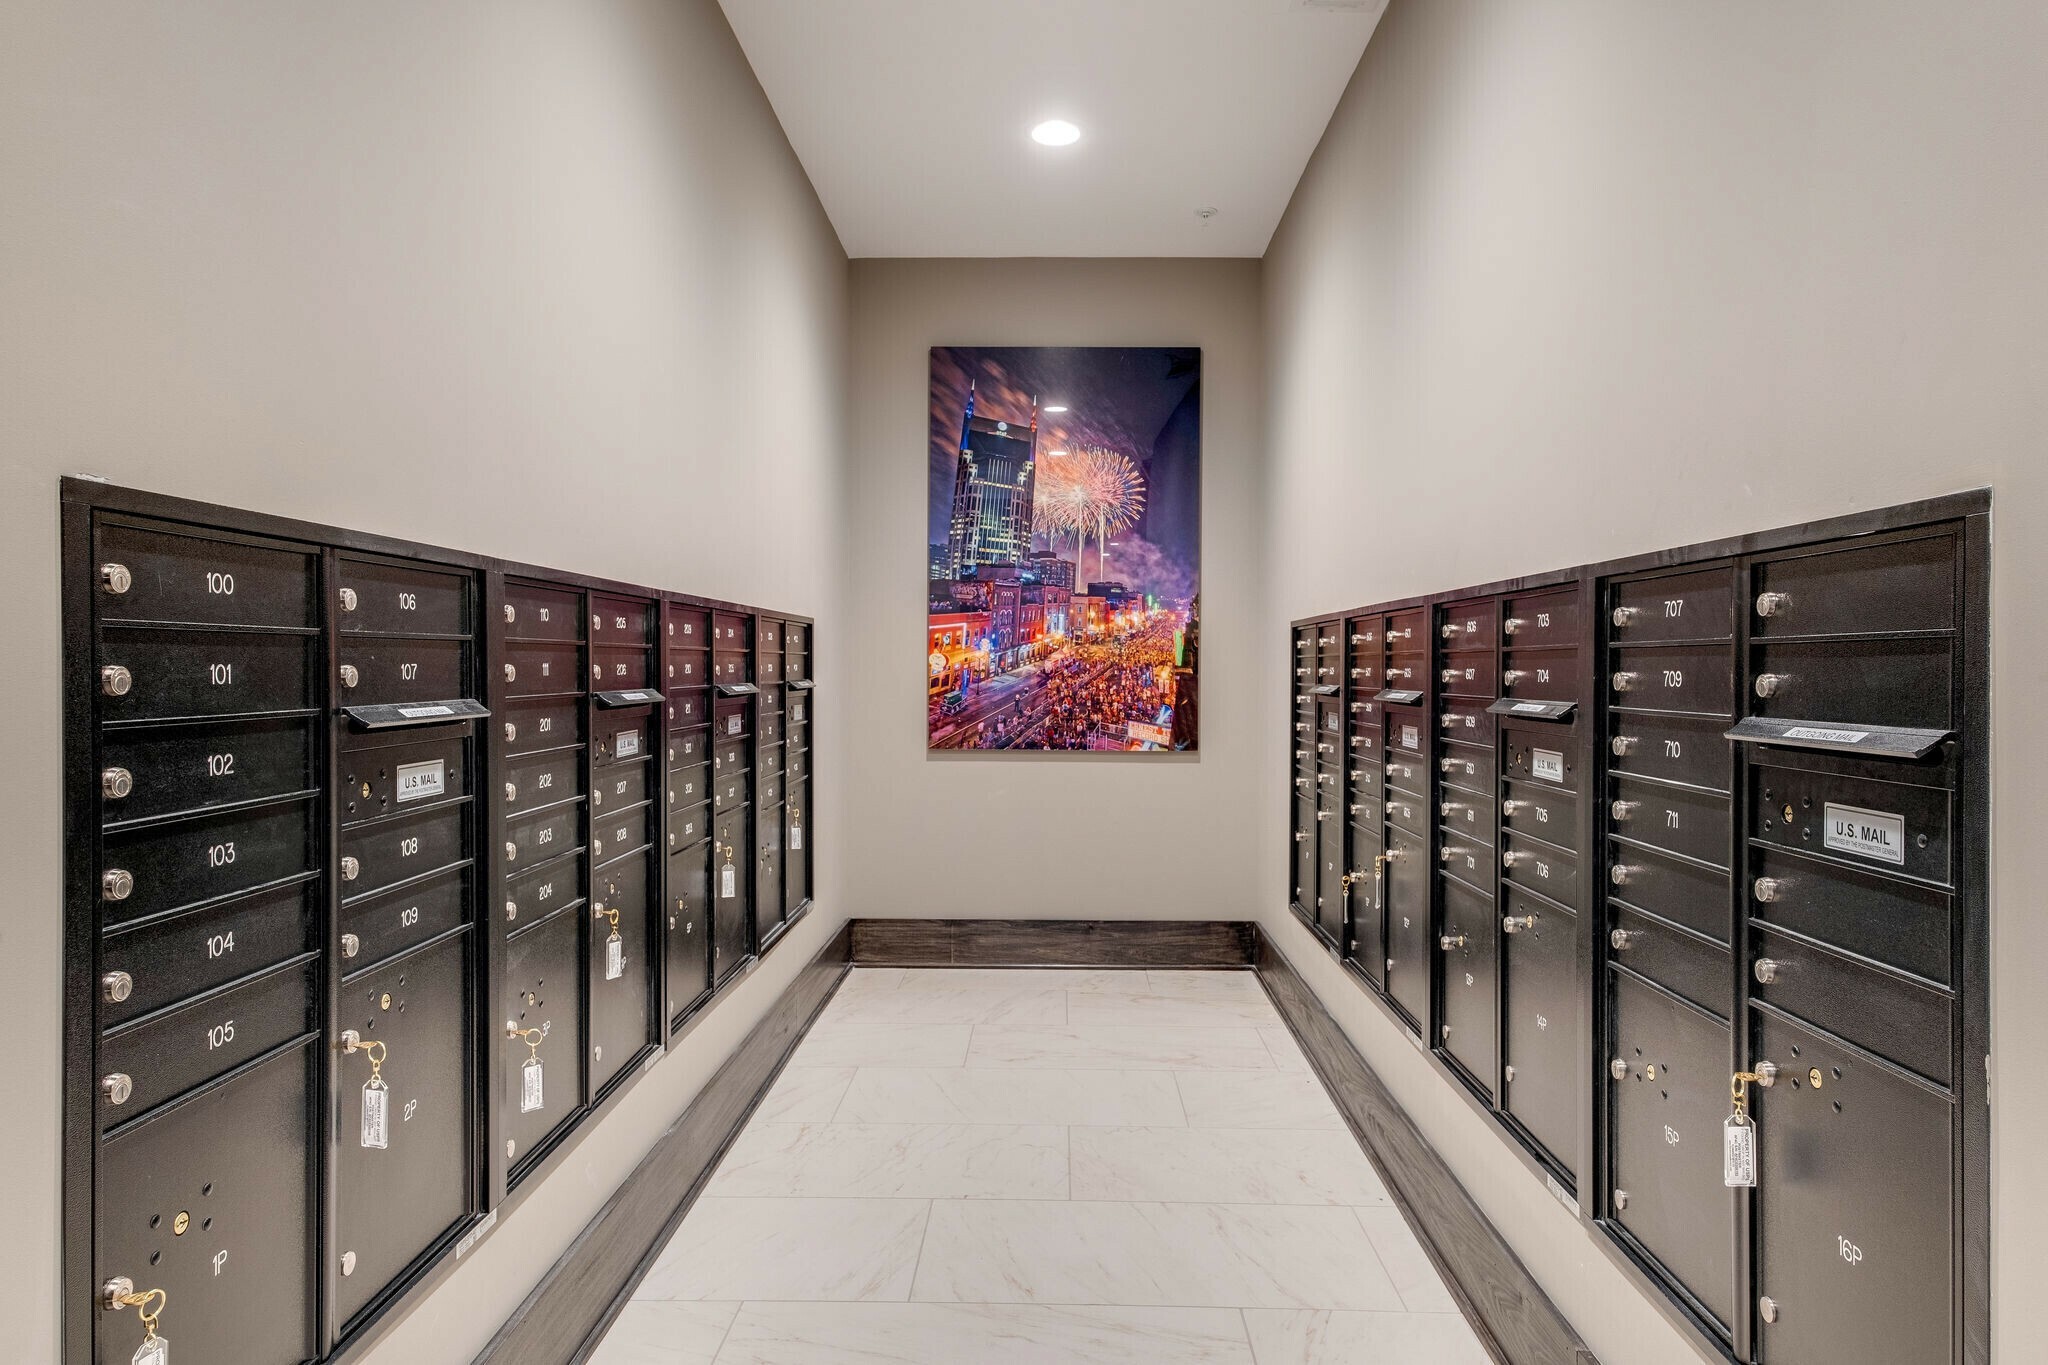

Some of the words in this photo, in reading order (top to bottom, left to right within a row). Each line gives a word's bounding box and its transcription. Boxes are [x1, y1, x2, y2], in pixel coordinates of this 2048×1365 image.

[206, 571, 234, 595] 100
[398, 592, 416, 611] 106
[1664, 599, 1684, 618] 707
[539, 607, 550, 622] 110
[615, 616, 627, 629] 205
[1537, 613, 1550, 628] 703
[1466, 620, 1477, 633] 606
[209, 663, 232, 685] 101
[400, 663, 418, 681] 107
[616, 663, 627, 676] 206
[1465, 668, 1476, 680] 607
[1536, 669, 1550, 683] 704
[1663, 670, 1683, 688] 709
[539, 717, 551, 732] 201
[1791, 729, 1835, 740] OUTGOING
[1664, 739, 1681, 758] 710
[207, 753, 235, 777] 102
[1546, 760, 1558, 772] MAIL
[404, 776, 419, 789] U.S.
[420, 773, 437, 786] MAIL
[538, 773, 552, 789] 202
[616, 780, 627, 795] 207
[1535, 806, 1548, 823] 705
[1665, 809, 1679, 829] 711
[539, 827, 553, 845] 203
[616, 827, 627, 842] 208
[1836, 821, 1857, 838] U.S.
[1861, 826, 1890, 845] MAIL
[208, 841, 236, 868] 103
[400, 837, 418, 857] 108
[1858, 842, 1881, 853] POSTMASTER
[1881, 847, 1899, 858] GENERAL
[1536, 861, 1549, 879] 706
[539, 882, 553, 901] 204
[400, 906, 419, 928] 109
[206, 931, 235, 959] 104
[1536, 1014, 1547, 1031] 14P
[207, 1020, 235, 1051] 105
[404, 1098, 417, 1122] 2P
[1663, 1124, 1680, 1147] 15P
[1745, 1158, 1750, 1167] OF
[1837, 1234, 1863, 1266] 16P
[212, 1249, 228, 1277] 1P
